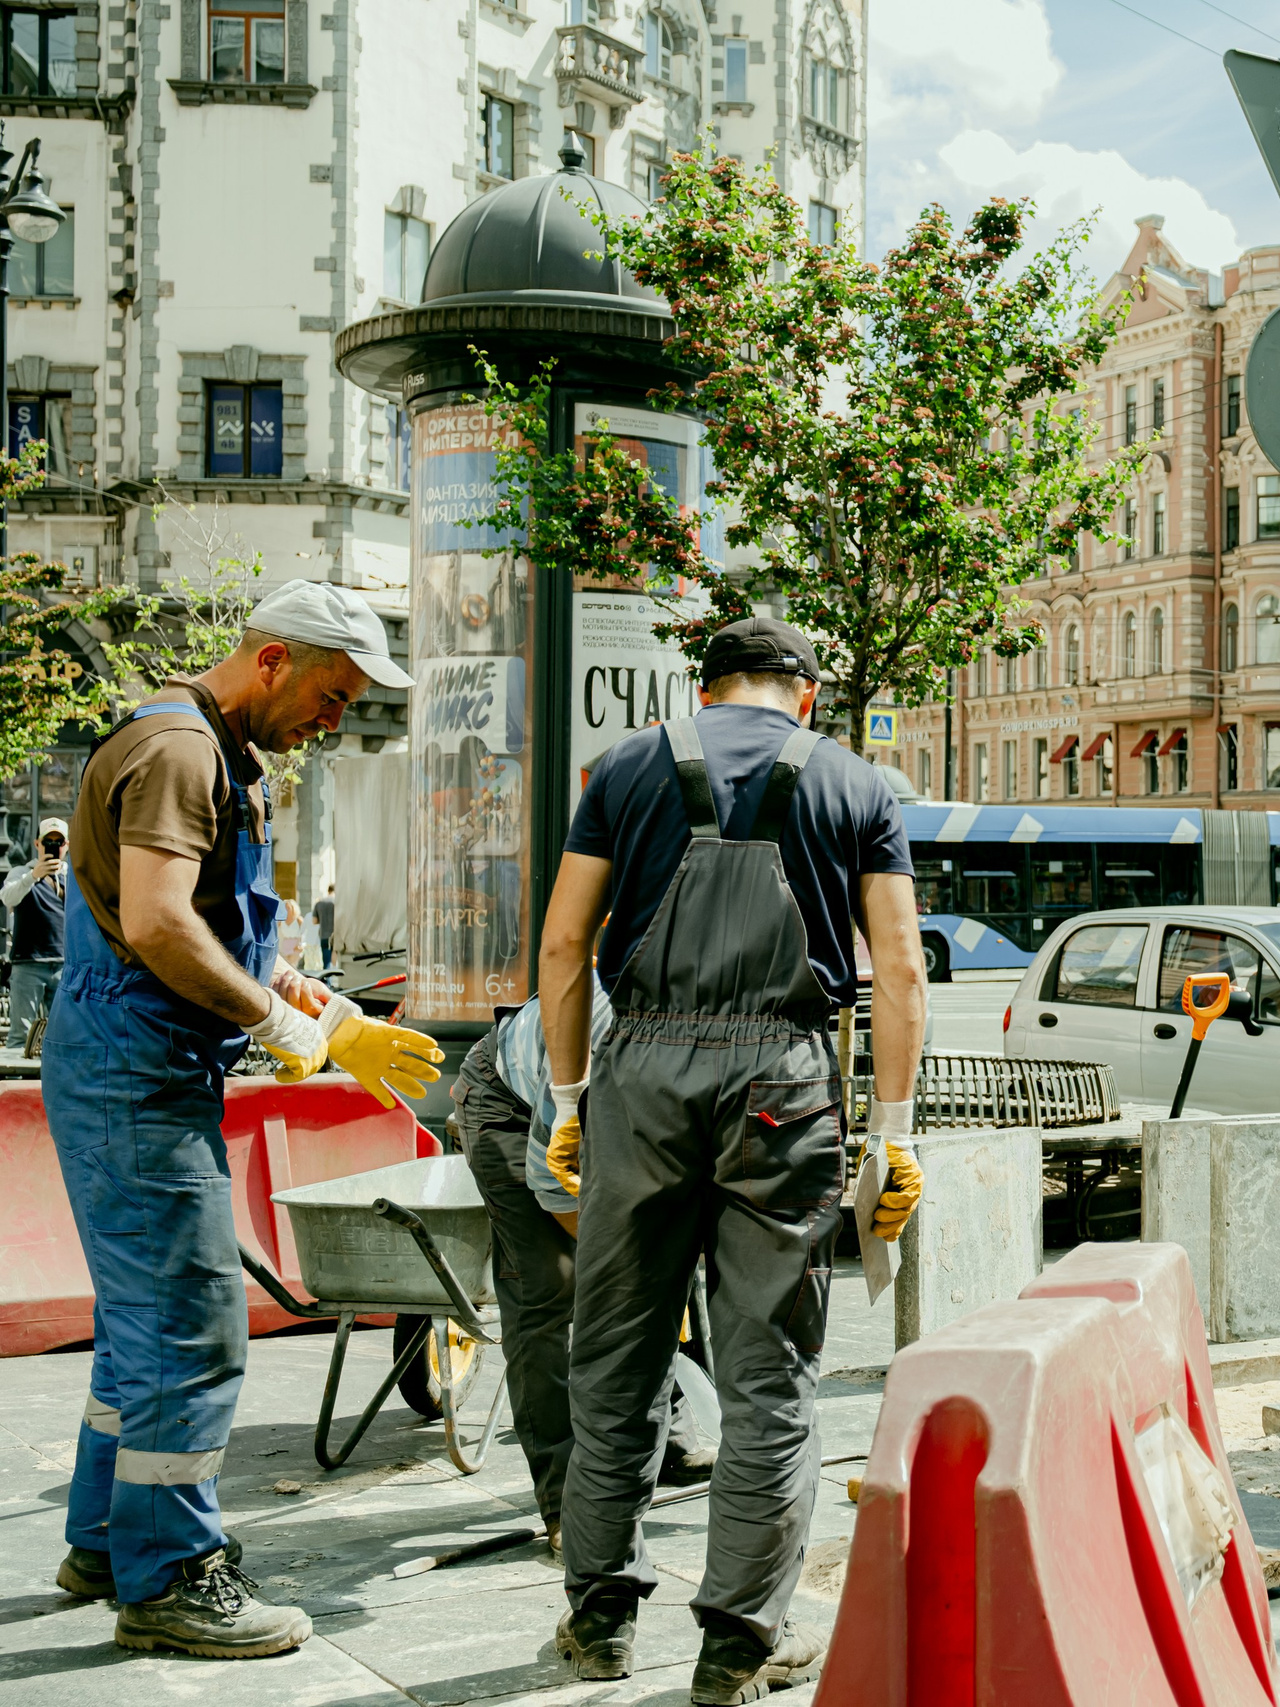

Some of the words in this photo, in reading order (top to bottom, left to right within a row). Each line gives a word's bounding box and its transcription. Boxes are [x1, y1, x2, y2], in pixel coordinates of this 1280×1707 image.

[424, 430, 519, 453] ИМПЕРИАЛ
[426, 482, 498, 501] ФАНТАЗИЯ
[584, 665, 694, 728] СЧАСТ
[425, 690, 494, 737] МИКС
[485, 973, 516, 996] 6+
